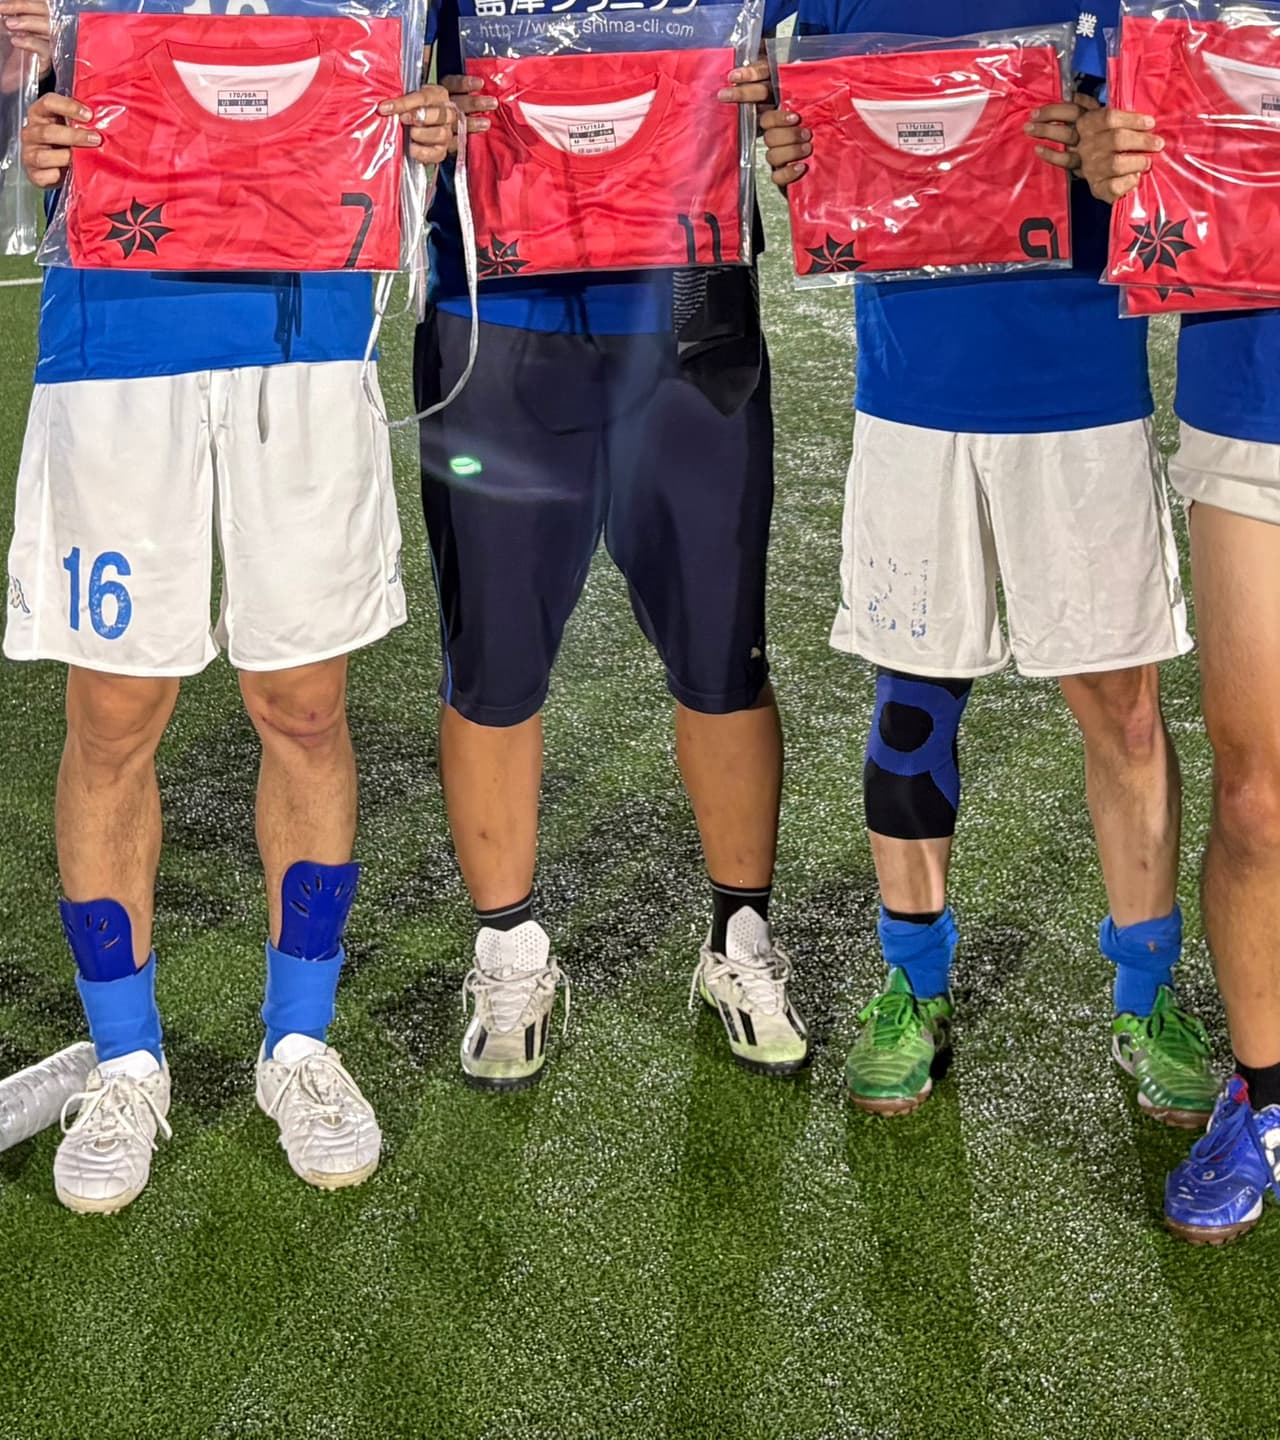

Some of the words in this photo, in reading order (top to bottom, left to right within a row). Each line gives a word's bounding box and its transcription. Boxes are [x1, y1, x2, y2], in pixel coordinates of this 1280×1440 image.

[340, 192, 374, 269] 7
[677, 211, 723, 266] 11
[62, 545, 133, 640] 16
